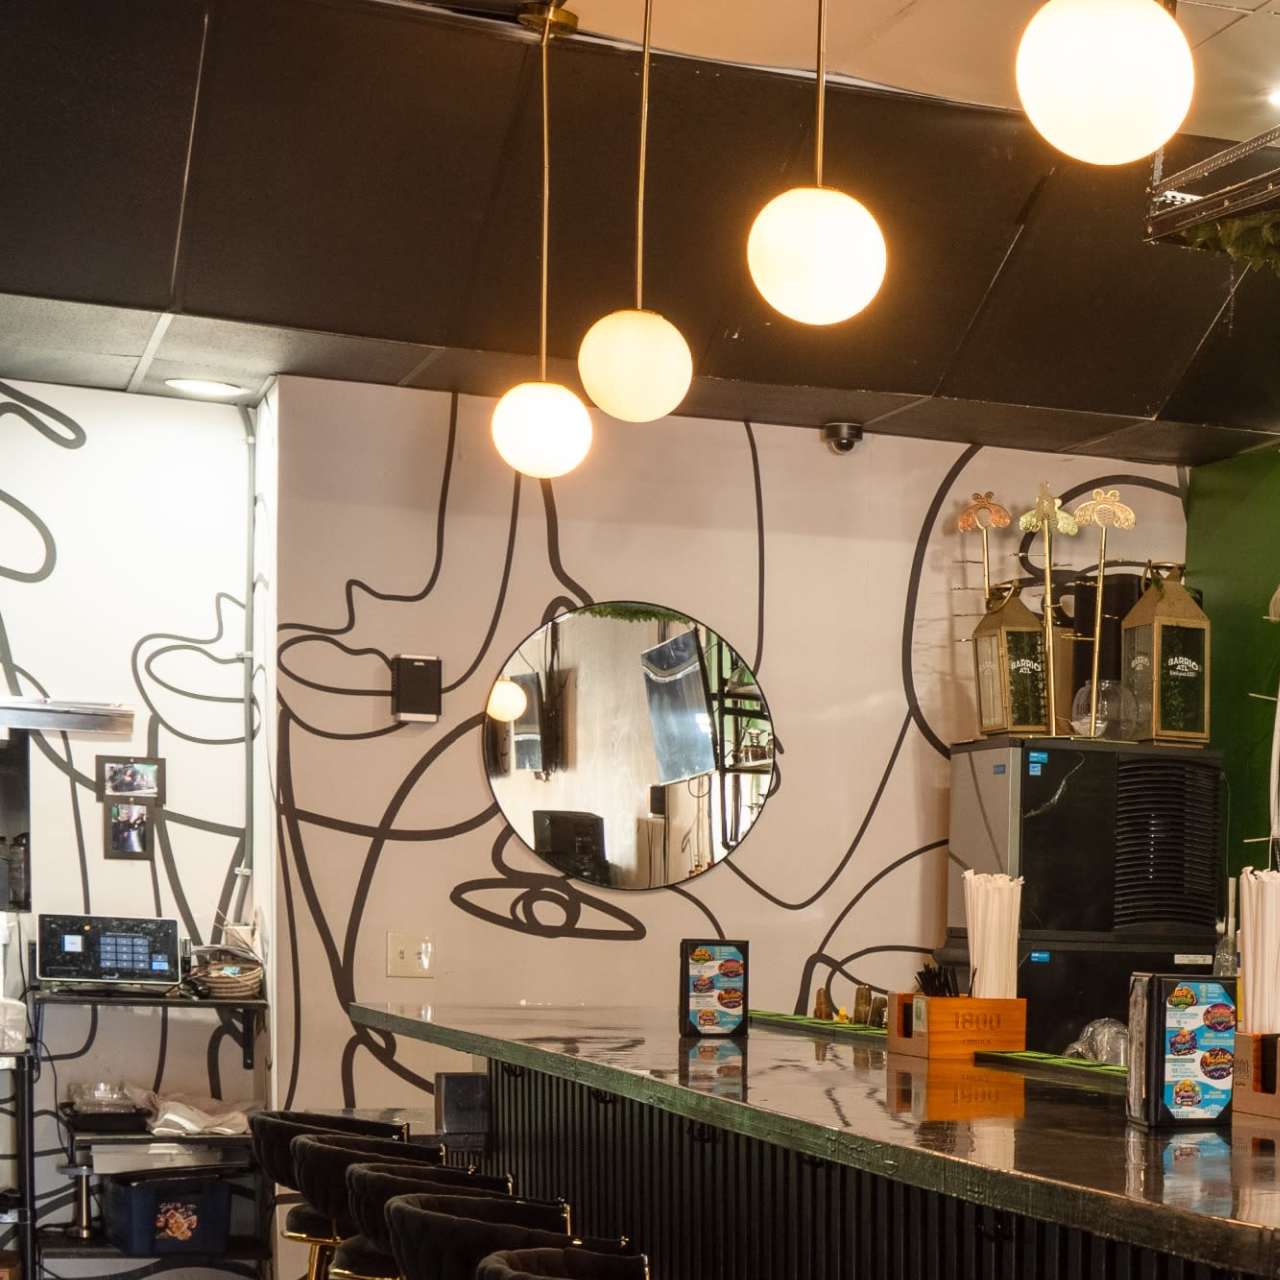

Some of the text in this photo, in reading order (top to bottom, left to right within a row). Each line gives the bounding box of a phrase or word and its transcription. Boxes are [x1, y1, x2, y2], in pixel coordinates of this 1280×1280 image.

[1010, 659, 1041, 672] BARRIO
[1168, 656, 1199, 671] BARRIO
[1176, 664, 1189, 672] ATL
[954, 1011, 1002, 1031] 1800
